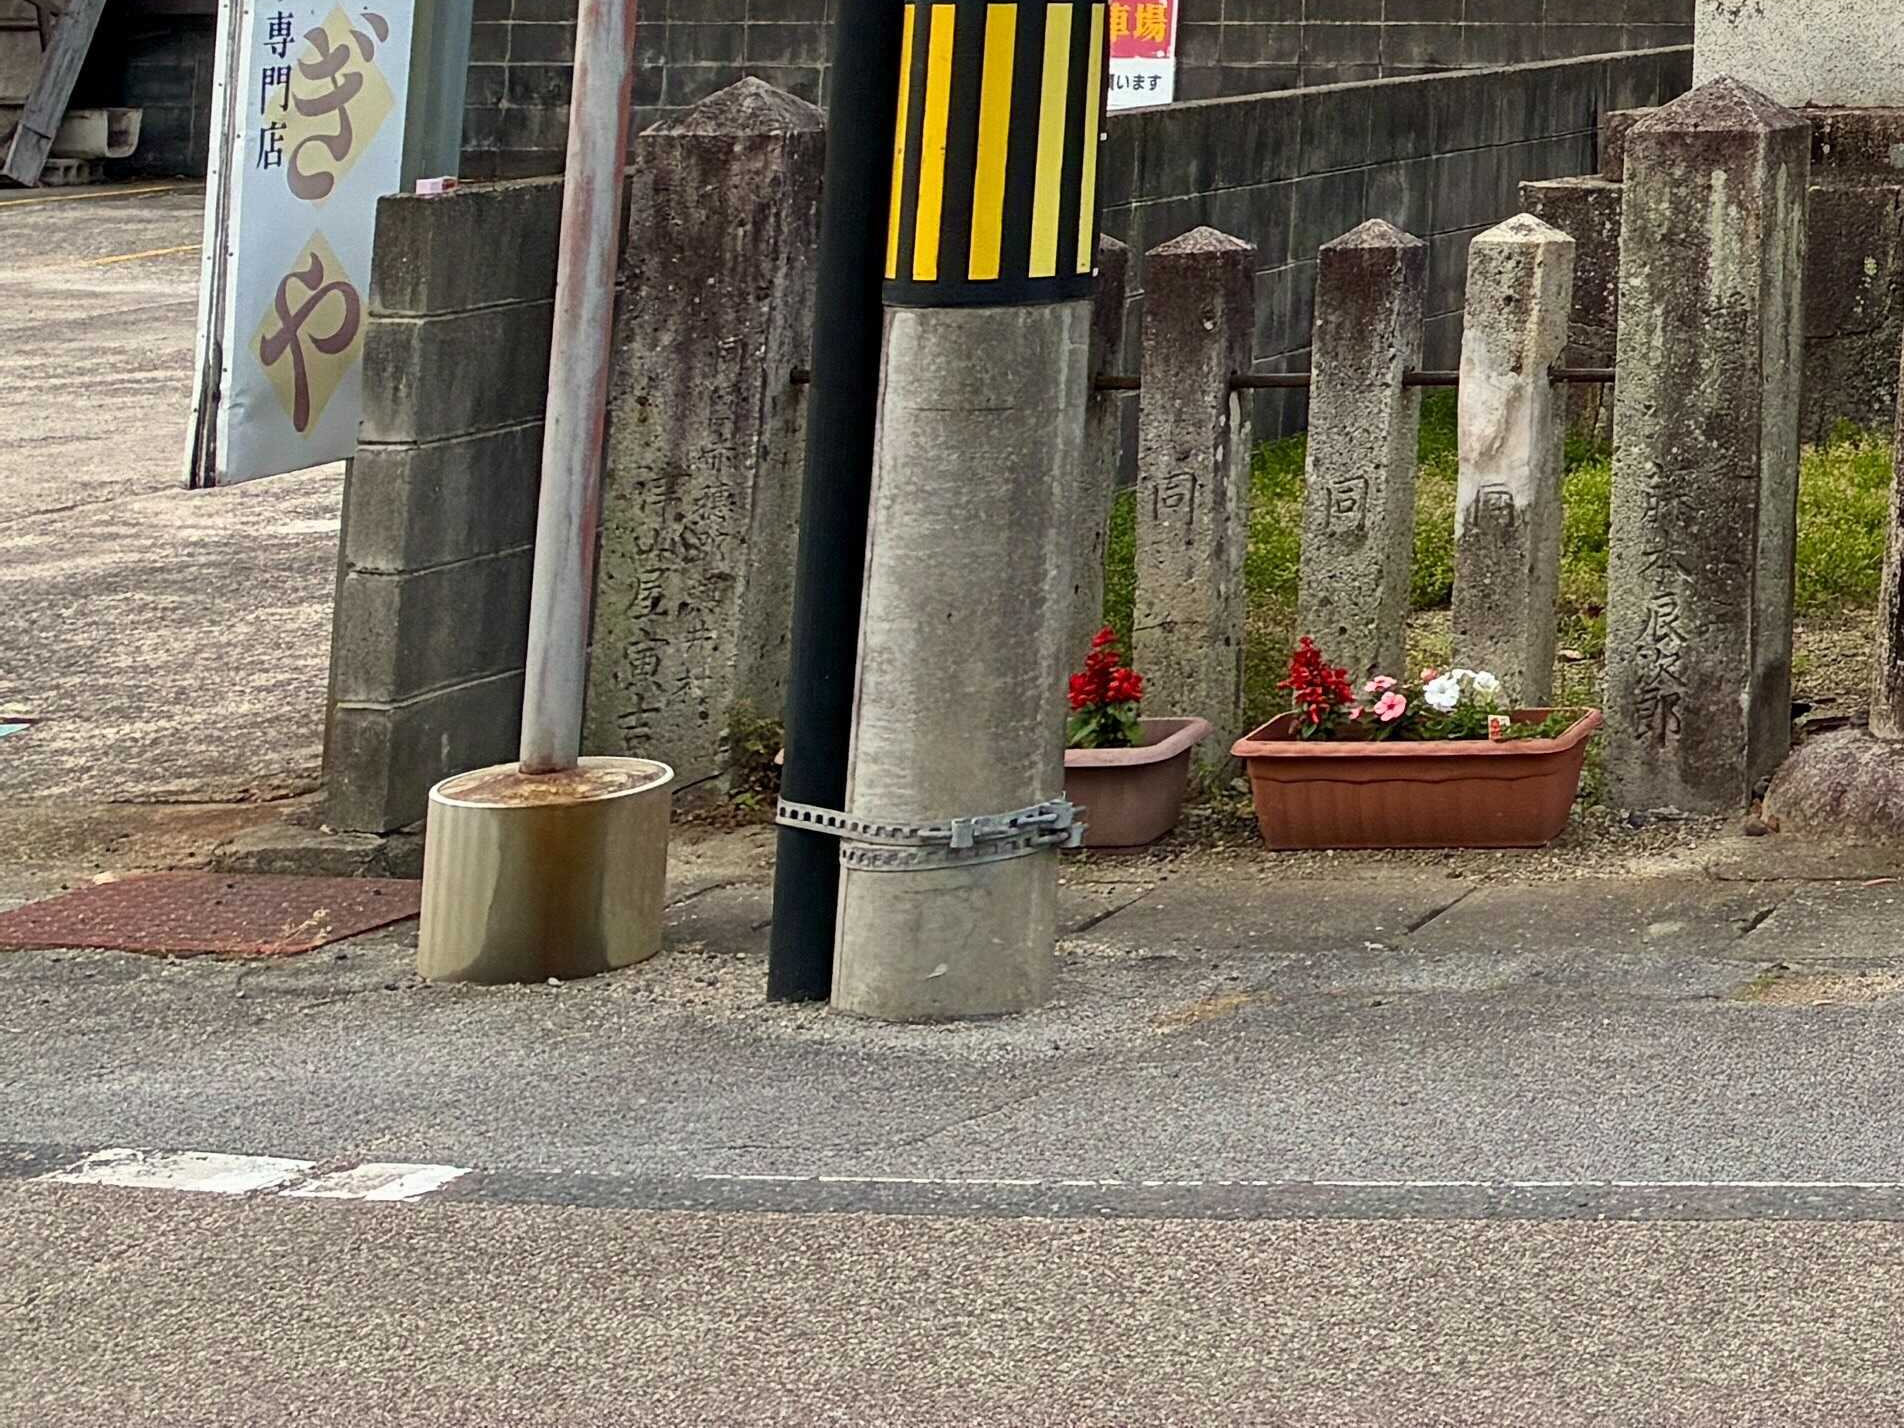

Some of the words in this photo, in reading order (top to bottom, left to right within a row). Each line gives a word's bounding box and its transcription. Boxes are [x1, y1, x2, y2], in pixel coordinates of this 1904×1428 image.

[1110, 74, 1162, 90] います
[1153, 471, 1197, 525] 同
[1325, 474, 1369, 532] 同
